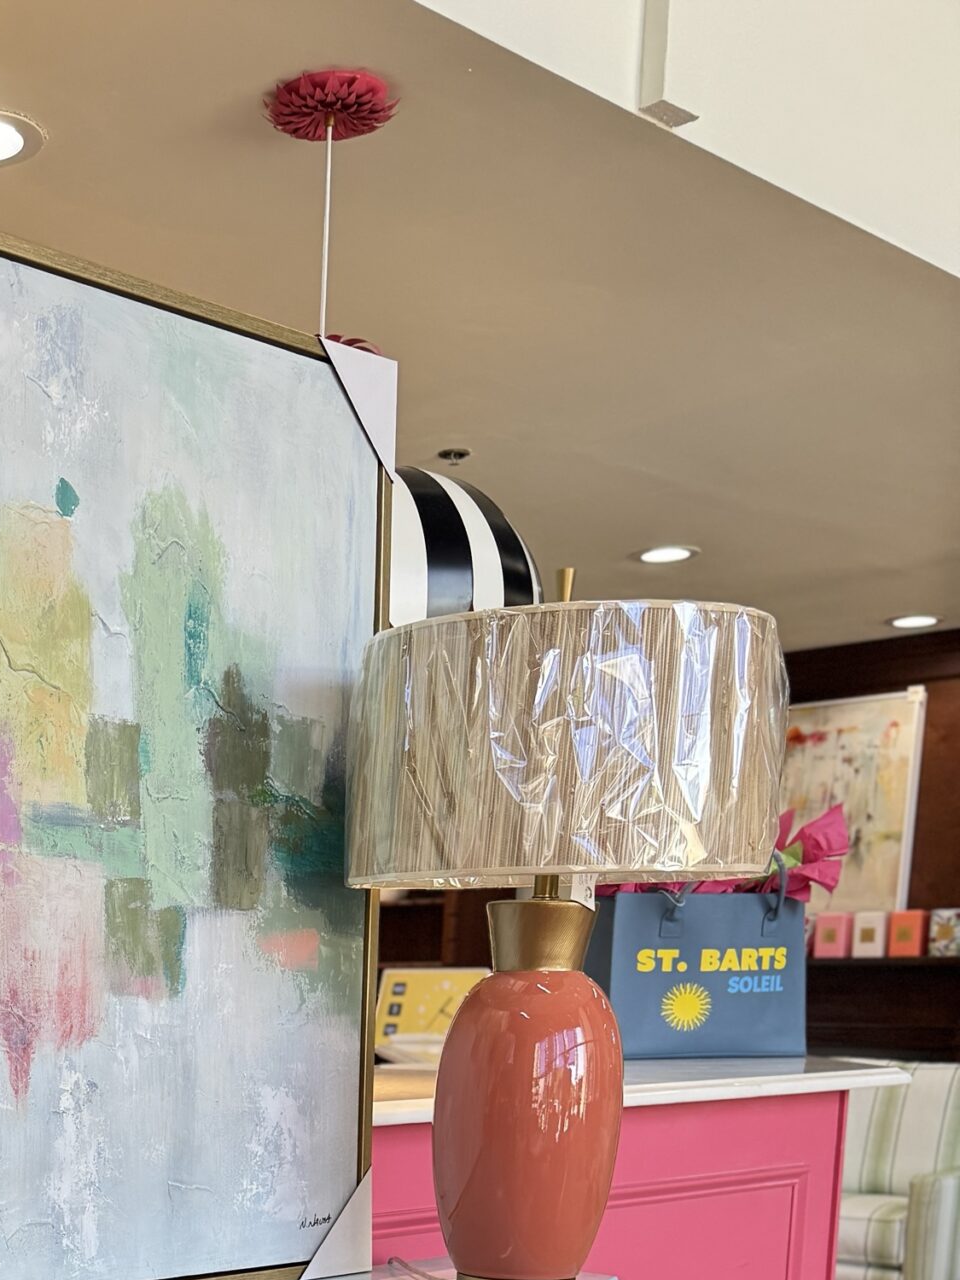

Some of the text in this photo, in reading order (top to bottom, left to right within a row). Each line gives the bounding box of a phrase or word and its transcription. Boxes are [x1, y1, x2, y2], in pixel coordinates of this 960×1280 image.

[636, 946, 787, 973] ST. BARTS
[727, 974, 784, 994] SOLEIL
